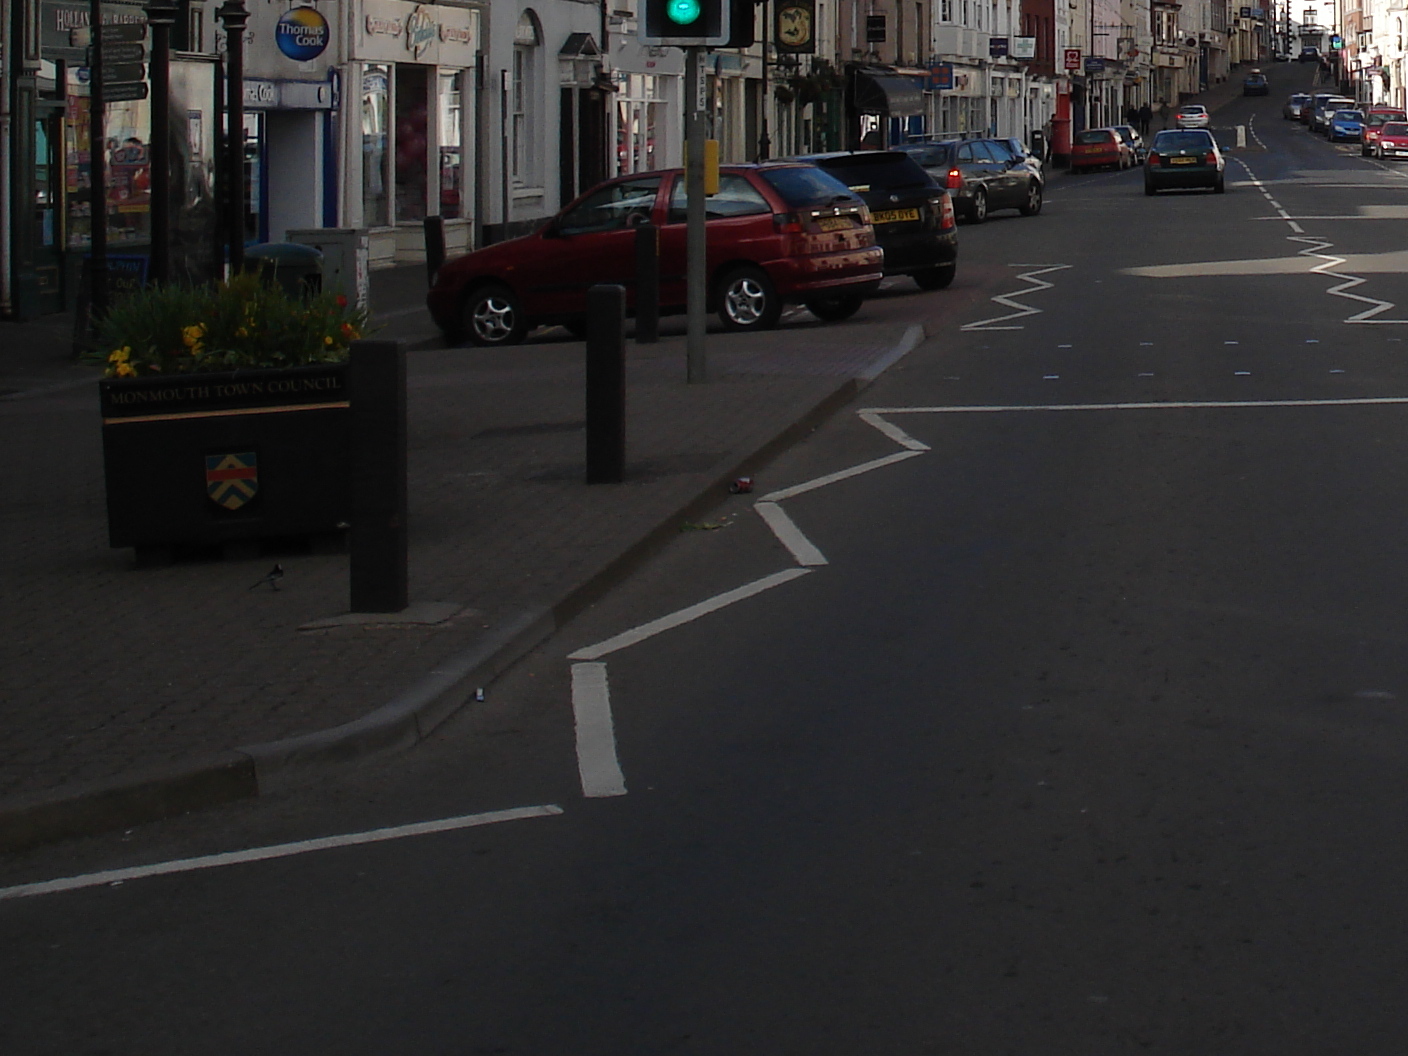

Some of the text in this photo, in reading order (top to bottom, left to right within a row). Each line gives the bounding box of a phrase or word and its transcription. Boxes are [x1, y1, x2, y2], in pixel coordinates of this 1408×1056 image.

[55, 9, 91, 32] HOLLAN
[279, 23, 324, 35] Thomas
[295, 35, 324, 46] Cook
[110, 376, 341, 405] MONMOUTH TOWN COUNCIL
